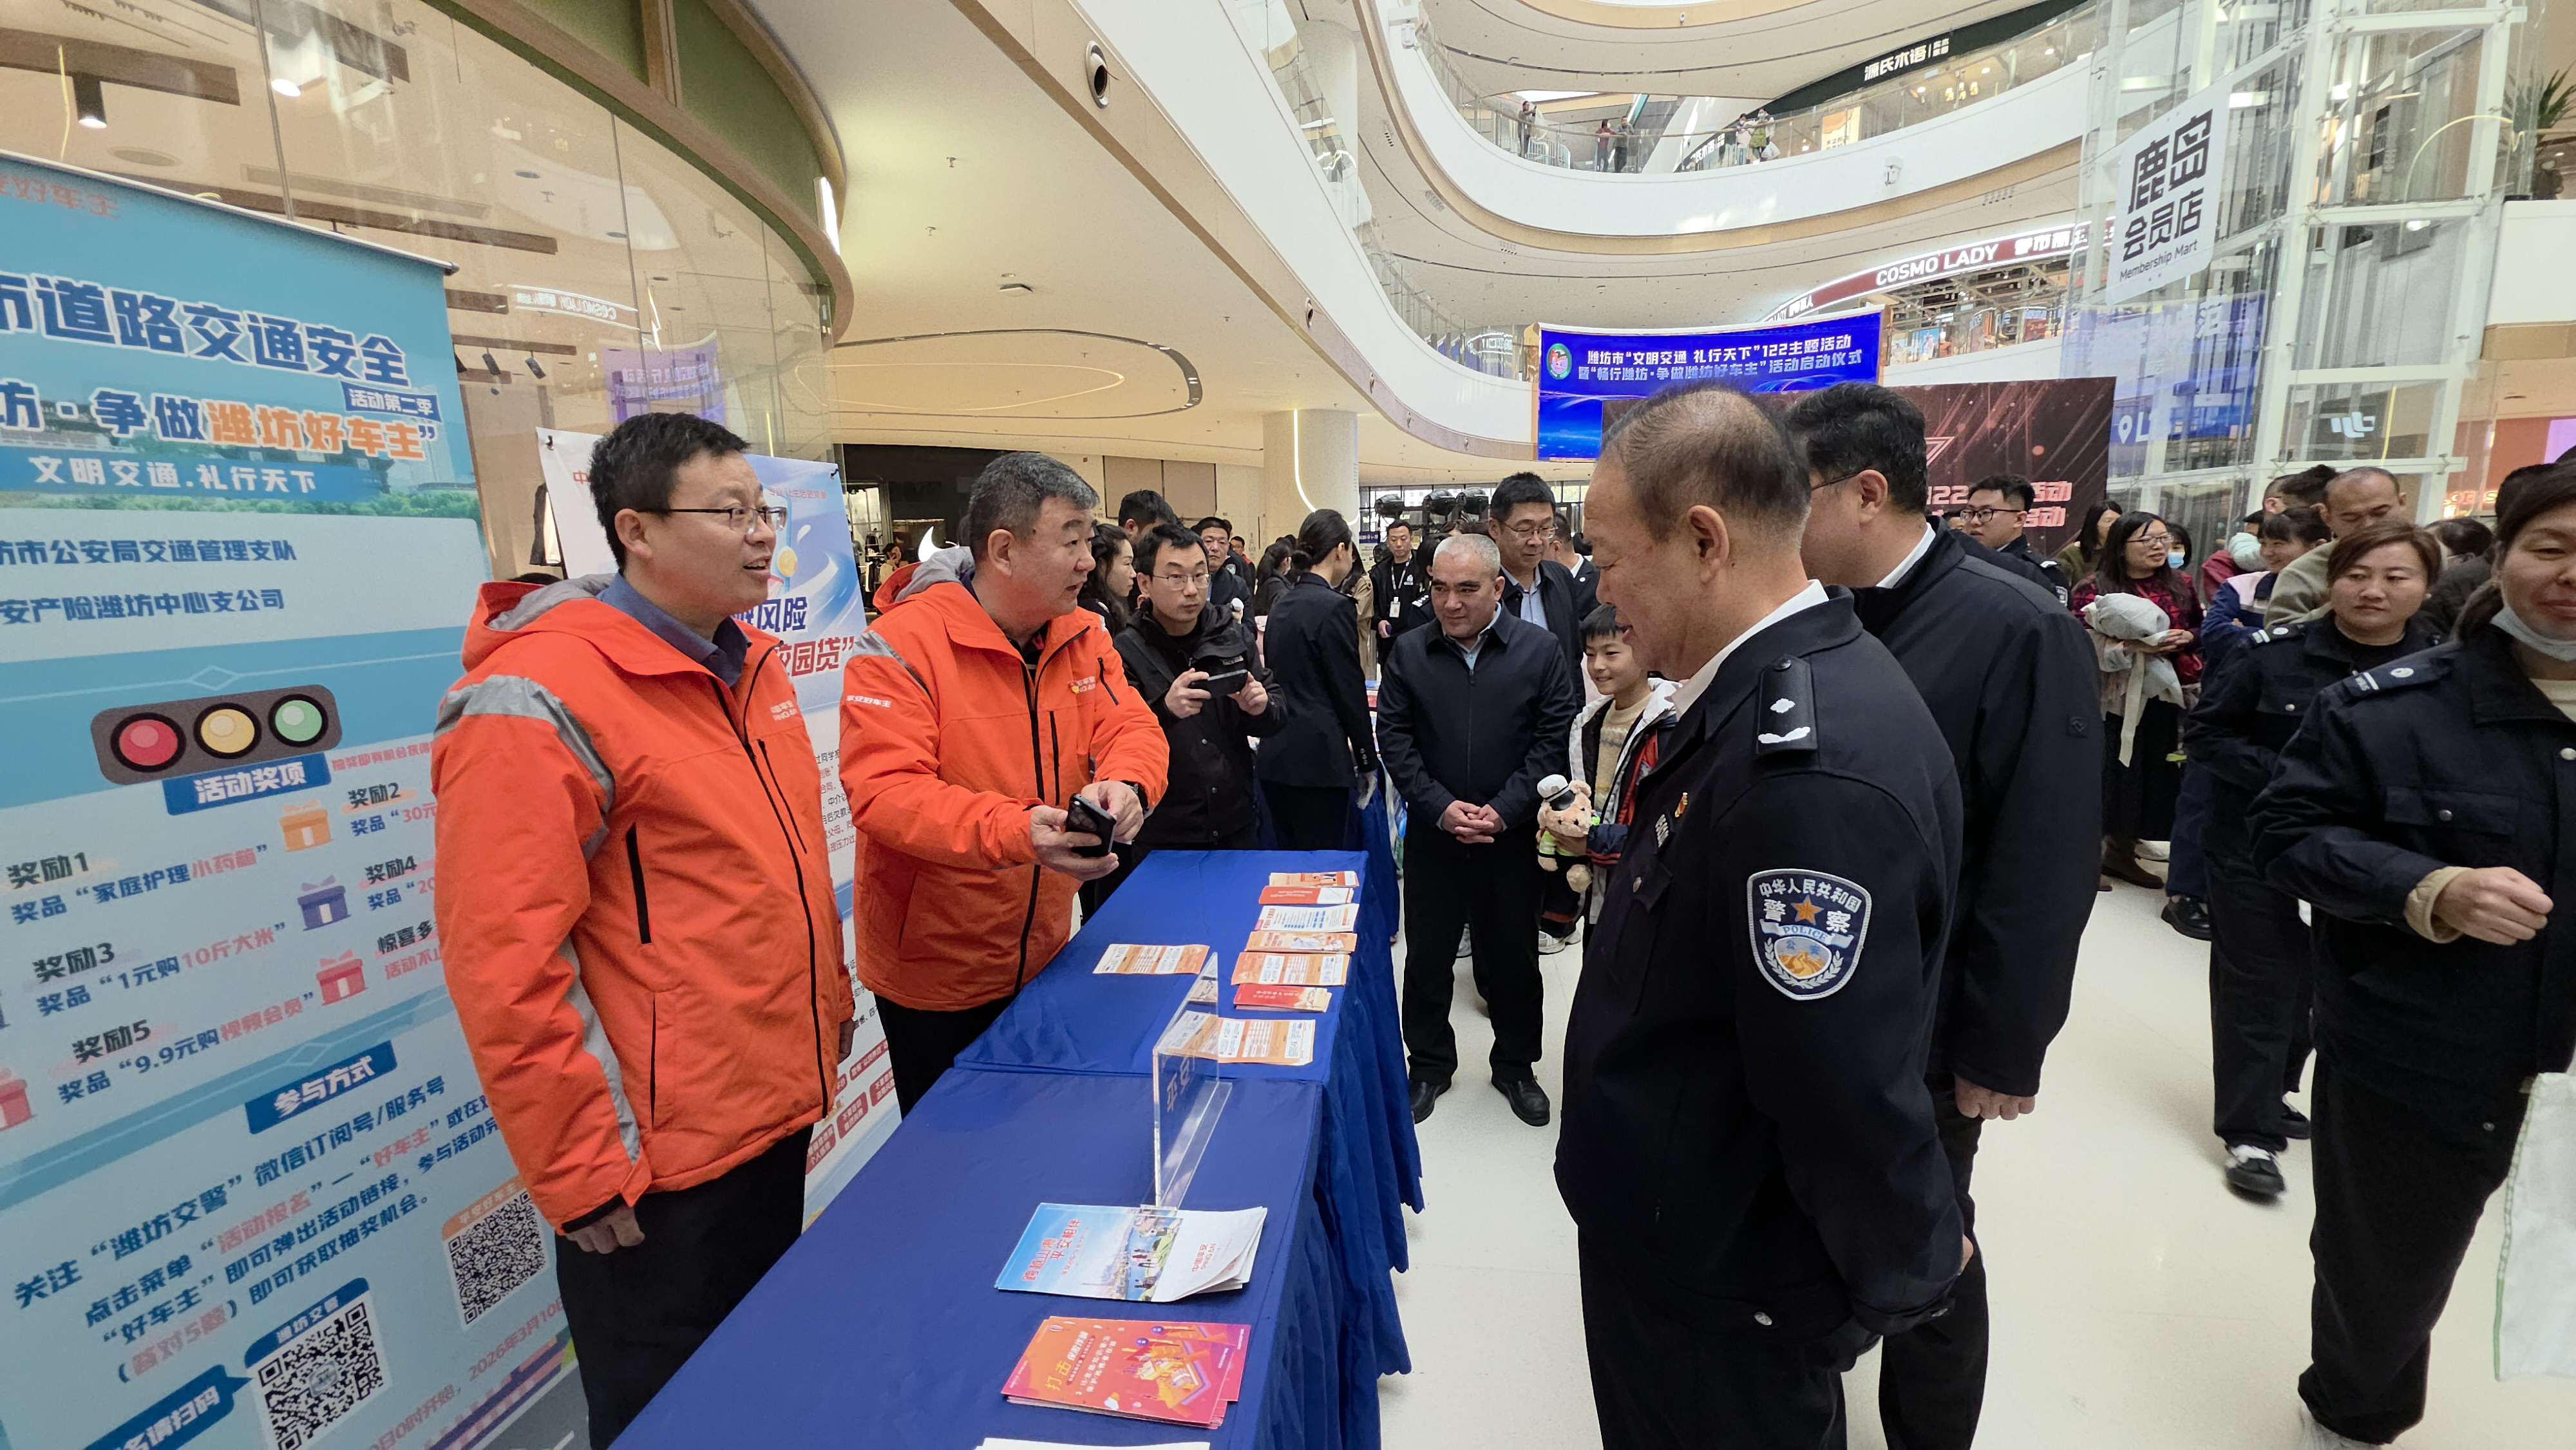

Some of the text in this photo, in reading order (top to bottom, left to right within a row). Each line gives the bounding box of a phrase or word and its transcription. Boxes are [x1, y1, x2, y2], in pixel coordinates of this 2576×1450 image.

[2128, 108, 2213, 214] 鹿岛
[2123, 189, 2204, 261] 会员店
[1876, 244, 1999, 287] COSMO LADY
[2119, 238, 2199, 282] Membership Mart
[349, 388, 433, 416] 活动第二季
[846, 695, 892, 708] 平安好车主
[332, 741, 431, 772] 抽奖即有机会获得
[194, 762, 307, 804] 活动奖项
[348, 782, 401, 809] 奖励2
[6, 852, 89, 890] 奖励1
[365, 855, 417, 885] 奖励4
[1759, 878, 1862, 914] 中华人民共和国
[1763, 899, 1852, 934] 警 察
[1783, 925, 1829, 941] POLICE
[377, 919, 437, 954] 惊喜多
[1786, 939, 1821, 954] 公 安
[32, 942, 117, 985] 奖励3
[71, 1019, 152, 1065] 奖励5
[274, 1055, 377, 1116] 参与方式
[276, 1295, 339, 1342] 潍坊交警
